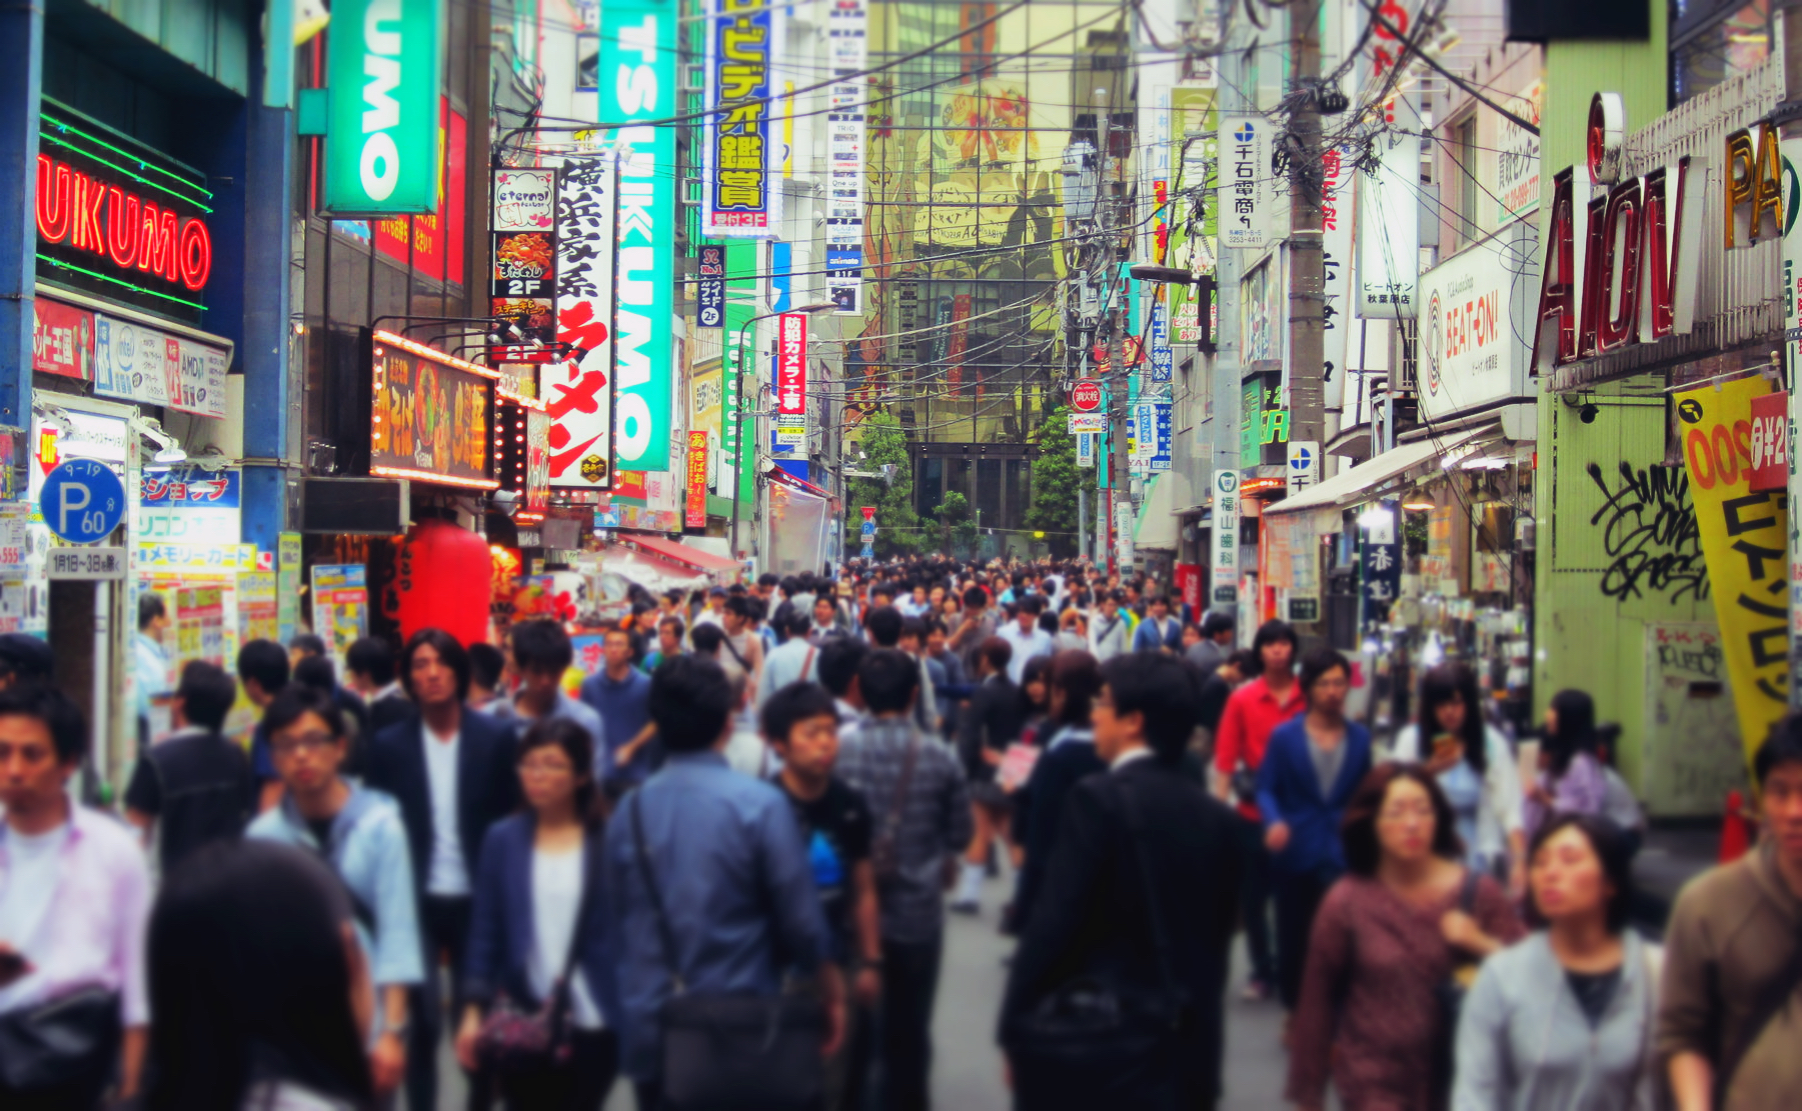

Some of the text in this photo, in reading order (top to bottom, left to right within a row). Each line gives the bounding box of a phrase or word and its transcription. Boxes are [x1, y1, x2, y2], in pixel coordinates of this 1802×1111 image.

[500, 190, 549, 202] eternal
[36, 153, 212, 292] UKUMO
[713, 212, 767, 228] 受付3F
[615, 14, 659, 461] TSUKUMO
[508, 280, 541, 295] 2F
[704, 311, 717, 321] 2F
[1446, 289, 1498, 359] BEAT-ON!
[182, 353, 198, 378] AMD
[784, 316, 802, 411] 防犯カメラ・工事
[1076, 391, 1099, 402] 消火栓
[65, 463, 101, 478] 9-19
[141, 478, 229, 501] ショップ
[59, 481, 91, 534] P
[81, 497, 115, 534] 60 分
[1220, 497, 1234, 567] 福山歯科
